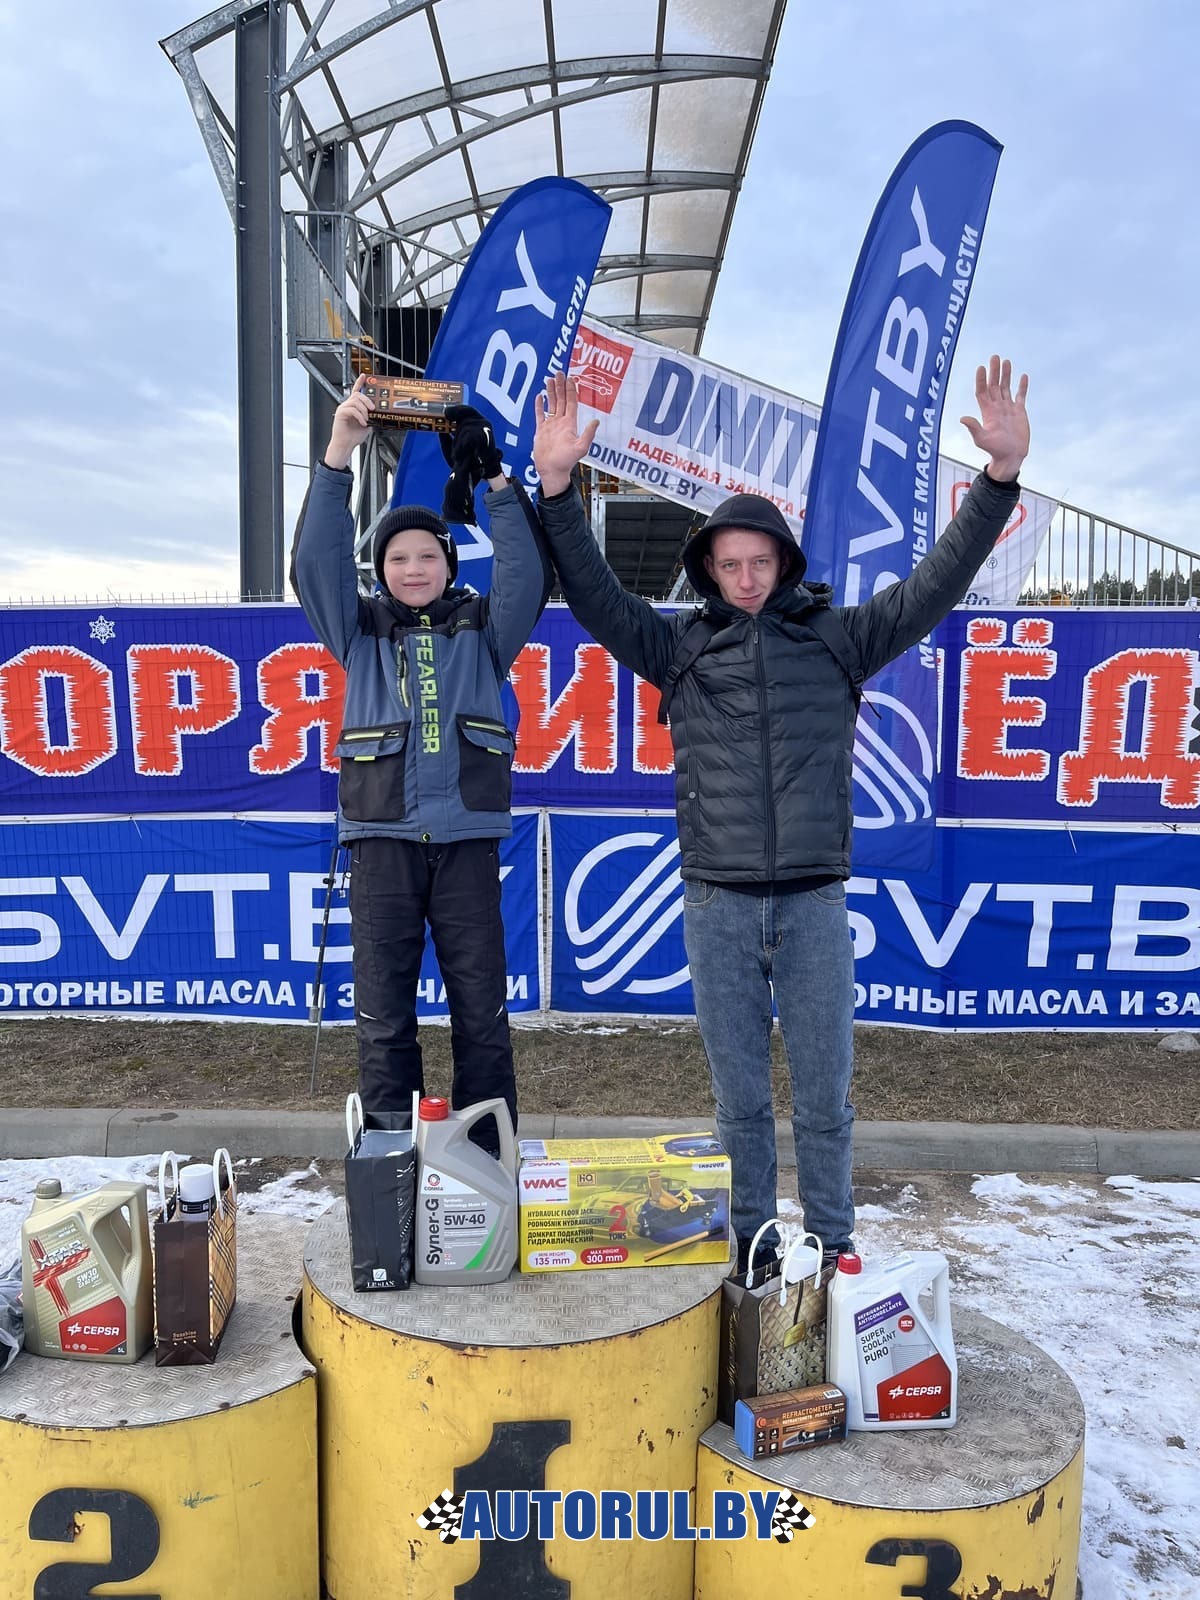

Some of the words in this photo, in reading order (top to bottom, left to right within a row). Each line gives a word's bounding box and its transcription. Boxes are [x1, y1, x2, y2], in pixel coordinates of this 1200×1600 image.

[573, 333, 624, 376] Pyrmo
[844, 185, 946, 607] VT.BY
[928, 376, 940, 400] И
[368, 413, 421, 423] EFRACTOMETER
[635, 357, 820, 496] DINIT
[588, 442, 703, 501] DINITROL.BY
[628, 437, 721, 486] НАДЕЖНАЯ
[0, 873, 514, 963] SVT.B
[176, 979, 296, 1007] МАСЛА
[987, 989, 1108, 1016] МАСЛА
[1119, 990, 1144, 1016] И
[523, 1178, 567, 1190] WMC
[444, 1213, 486, 1226] 5W-40
[527, 1209, 560, 1218] HYDRAULIC
[608, 1204, 627, 1232] 2
[425, 1198, 443, 1265] Syner-G
[527, 1231, 556, 1239] ДОМКРАТ
[527, 1236, 594, 1246] ГИДРАВЛИЧЕСКИЙ
[608, 1232, 627, 1241] TONS
[534, 1257, 550, 1266] 135
[552, 1257, 570, 1265] mm
[586, 1255, 603, 1264] 300
[605, 1254, 623, 1262] mm
[860, 1327, 886, 1345] SUPER
[862, 1330, 896, 1353] COOLANT
[864, 1346, 889, 1364] PURO
[782, 1403, 833, 1420] REFRACTOMETER
[453, 1419, 571, 1600] 1
[28, 1487, 161, 1600] 2
